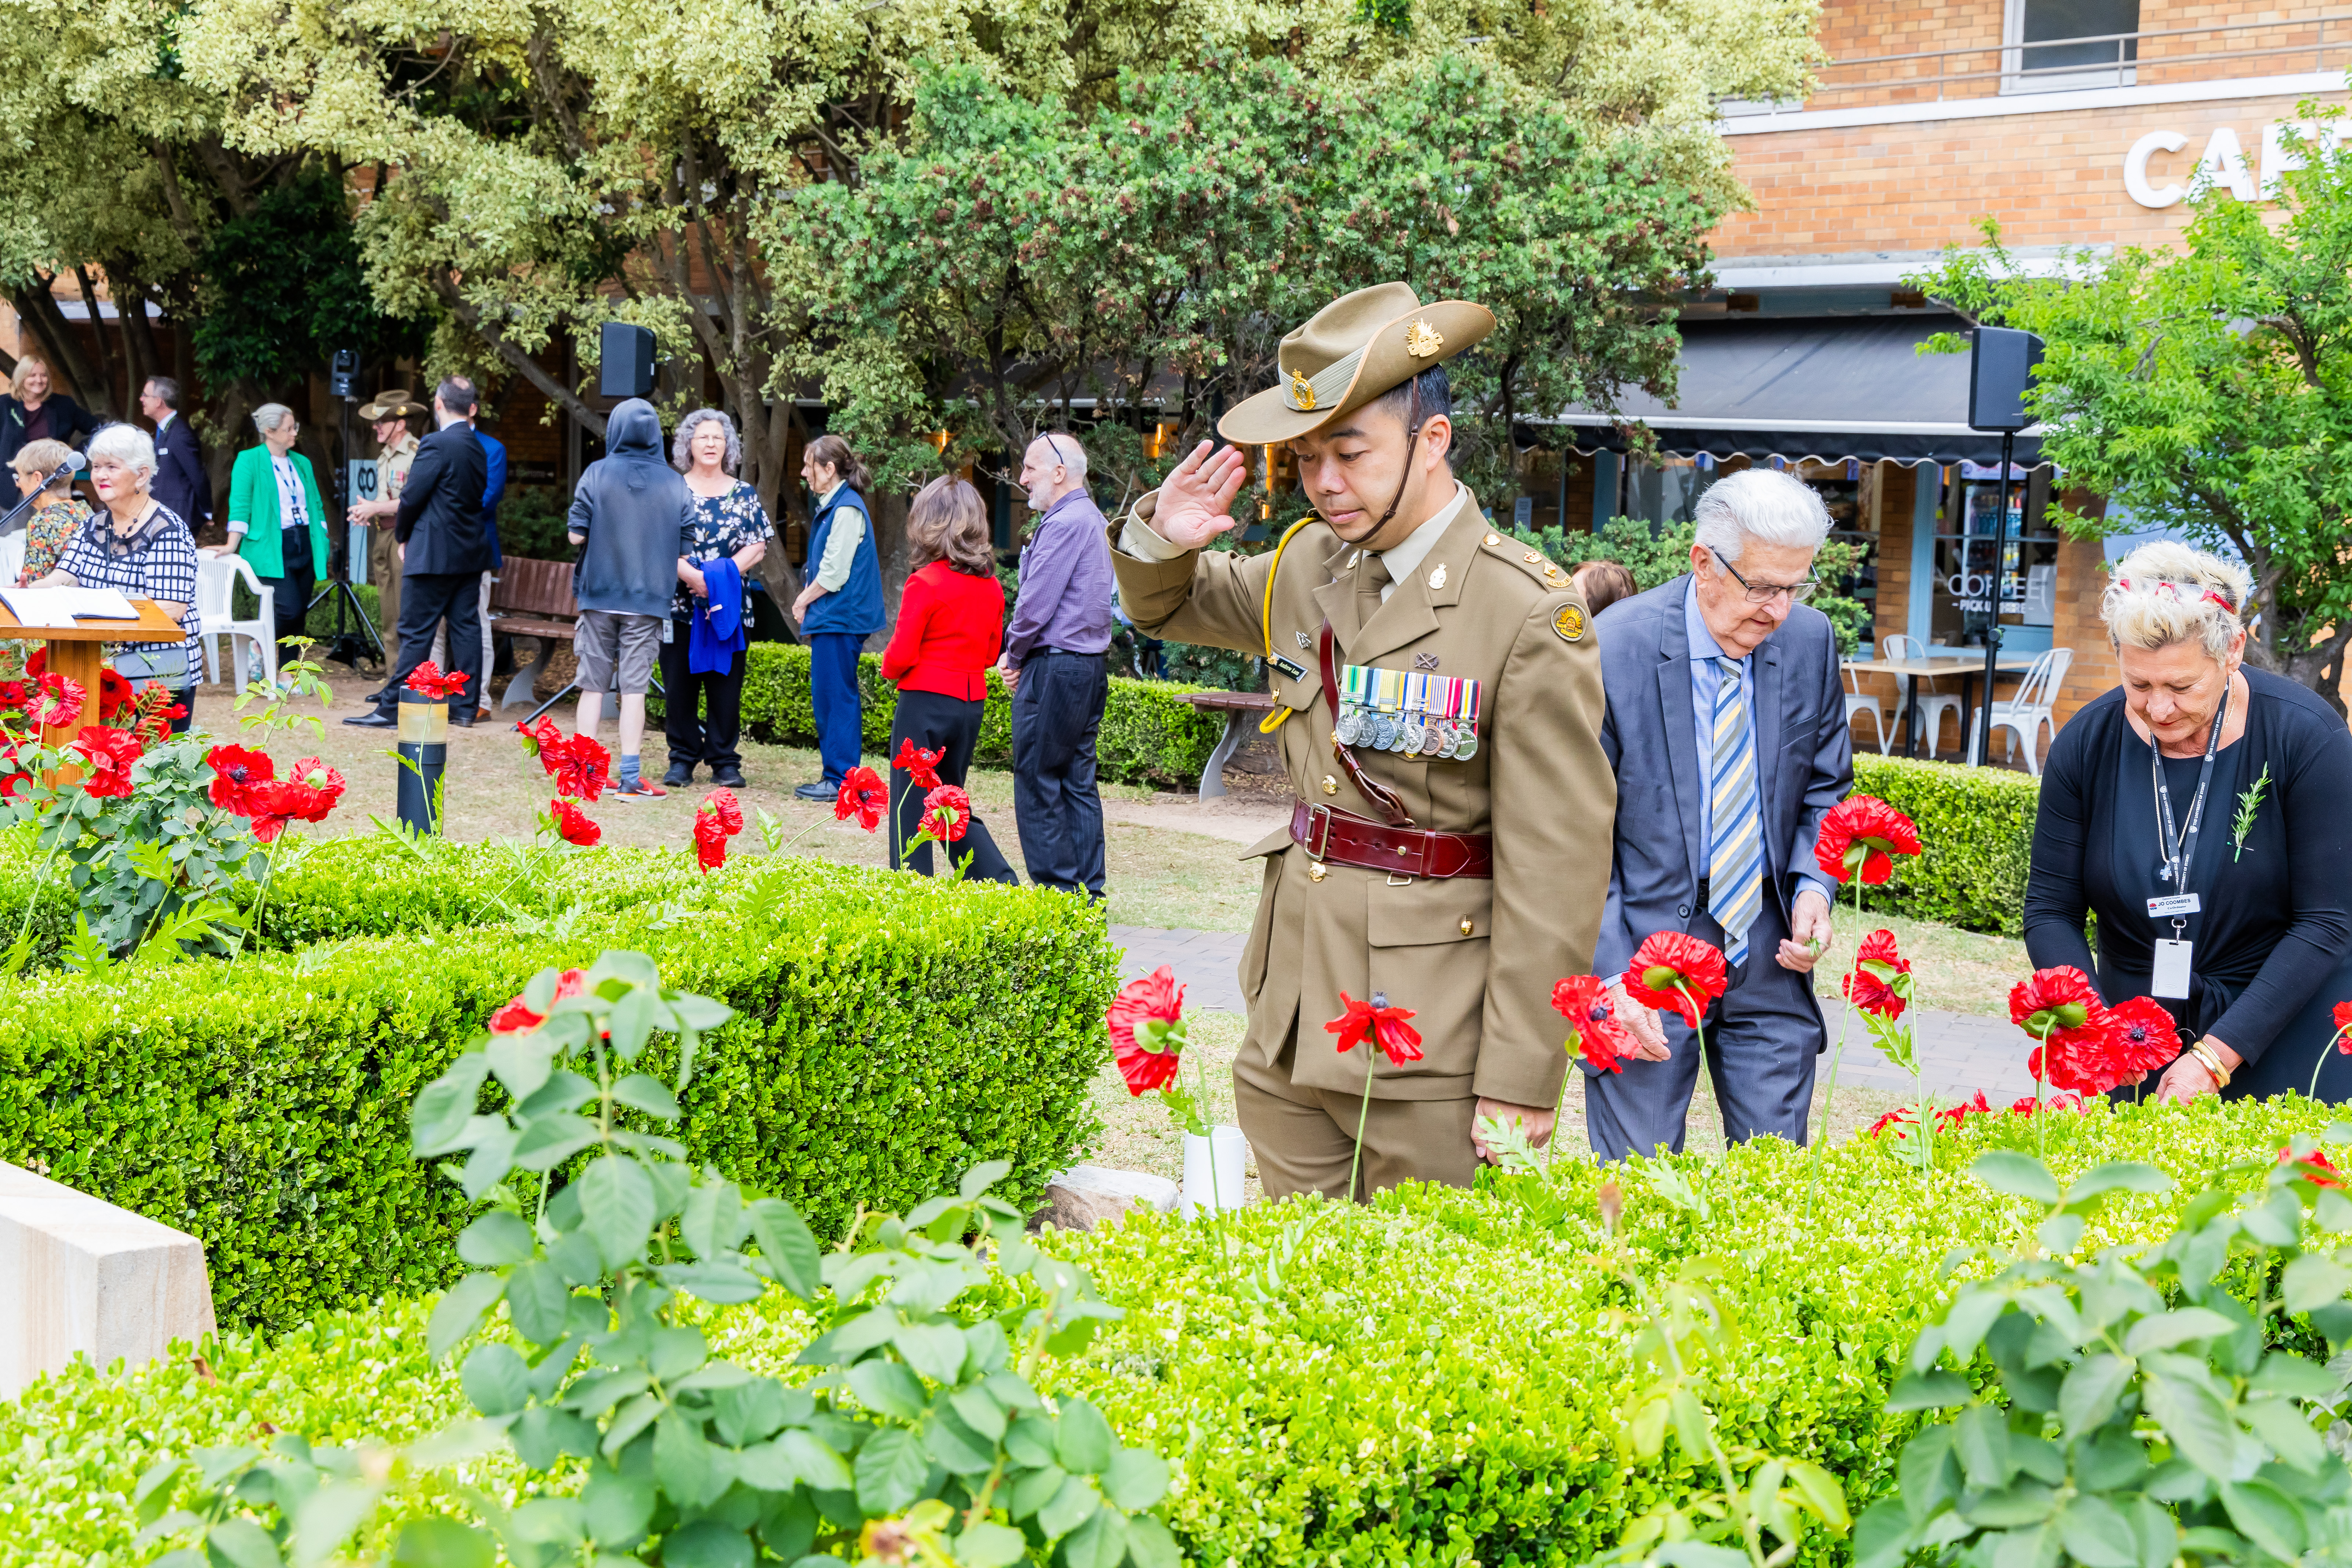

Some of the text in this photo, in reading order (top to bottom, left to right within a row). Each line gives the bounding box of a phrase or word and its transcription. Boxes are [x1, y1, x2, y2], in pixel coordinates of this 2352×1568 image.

[1960, 599, 1983, 612] PICK
[1279, 662, 1292, 671] Andrew
[2210, 728, 2218, 747] UNIVERSITY
